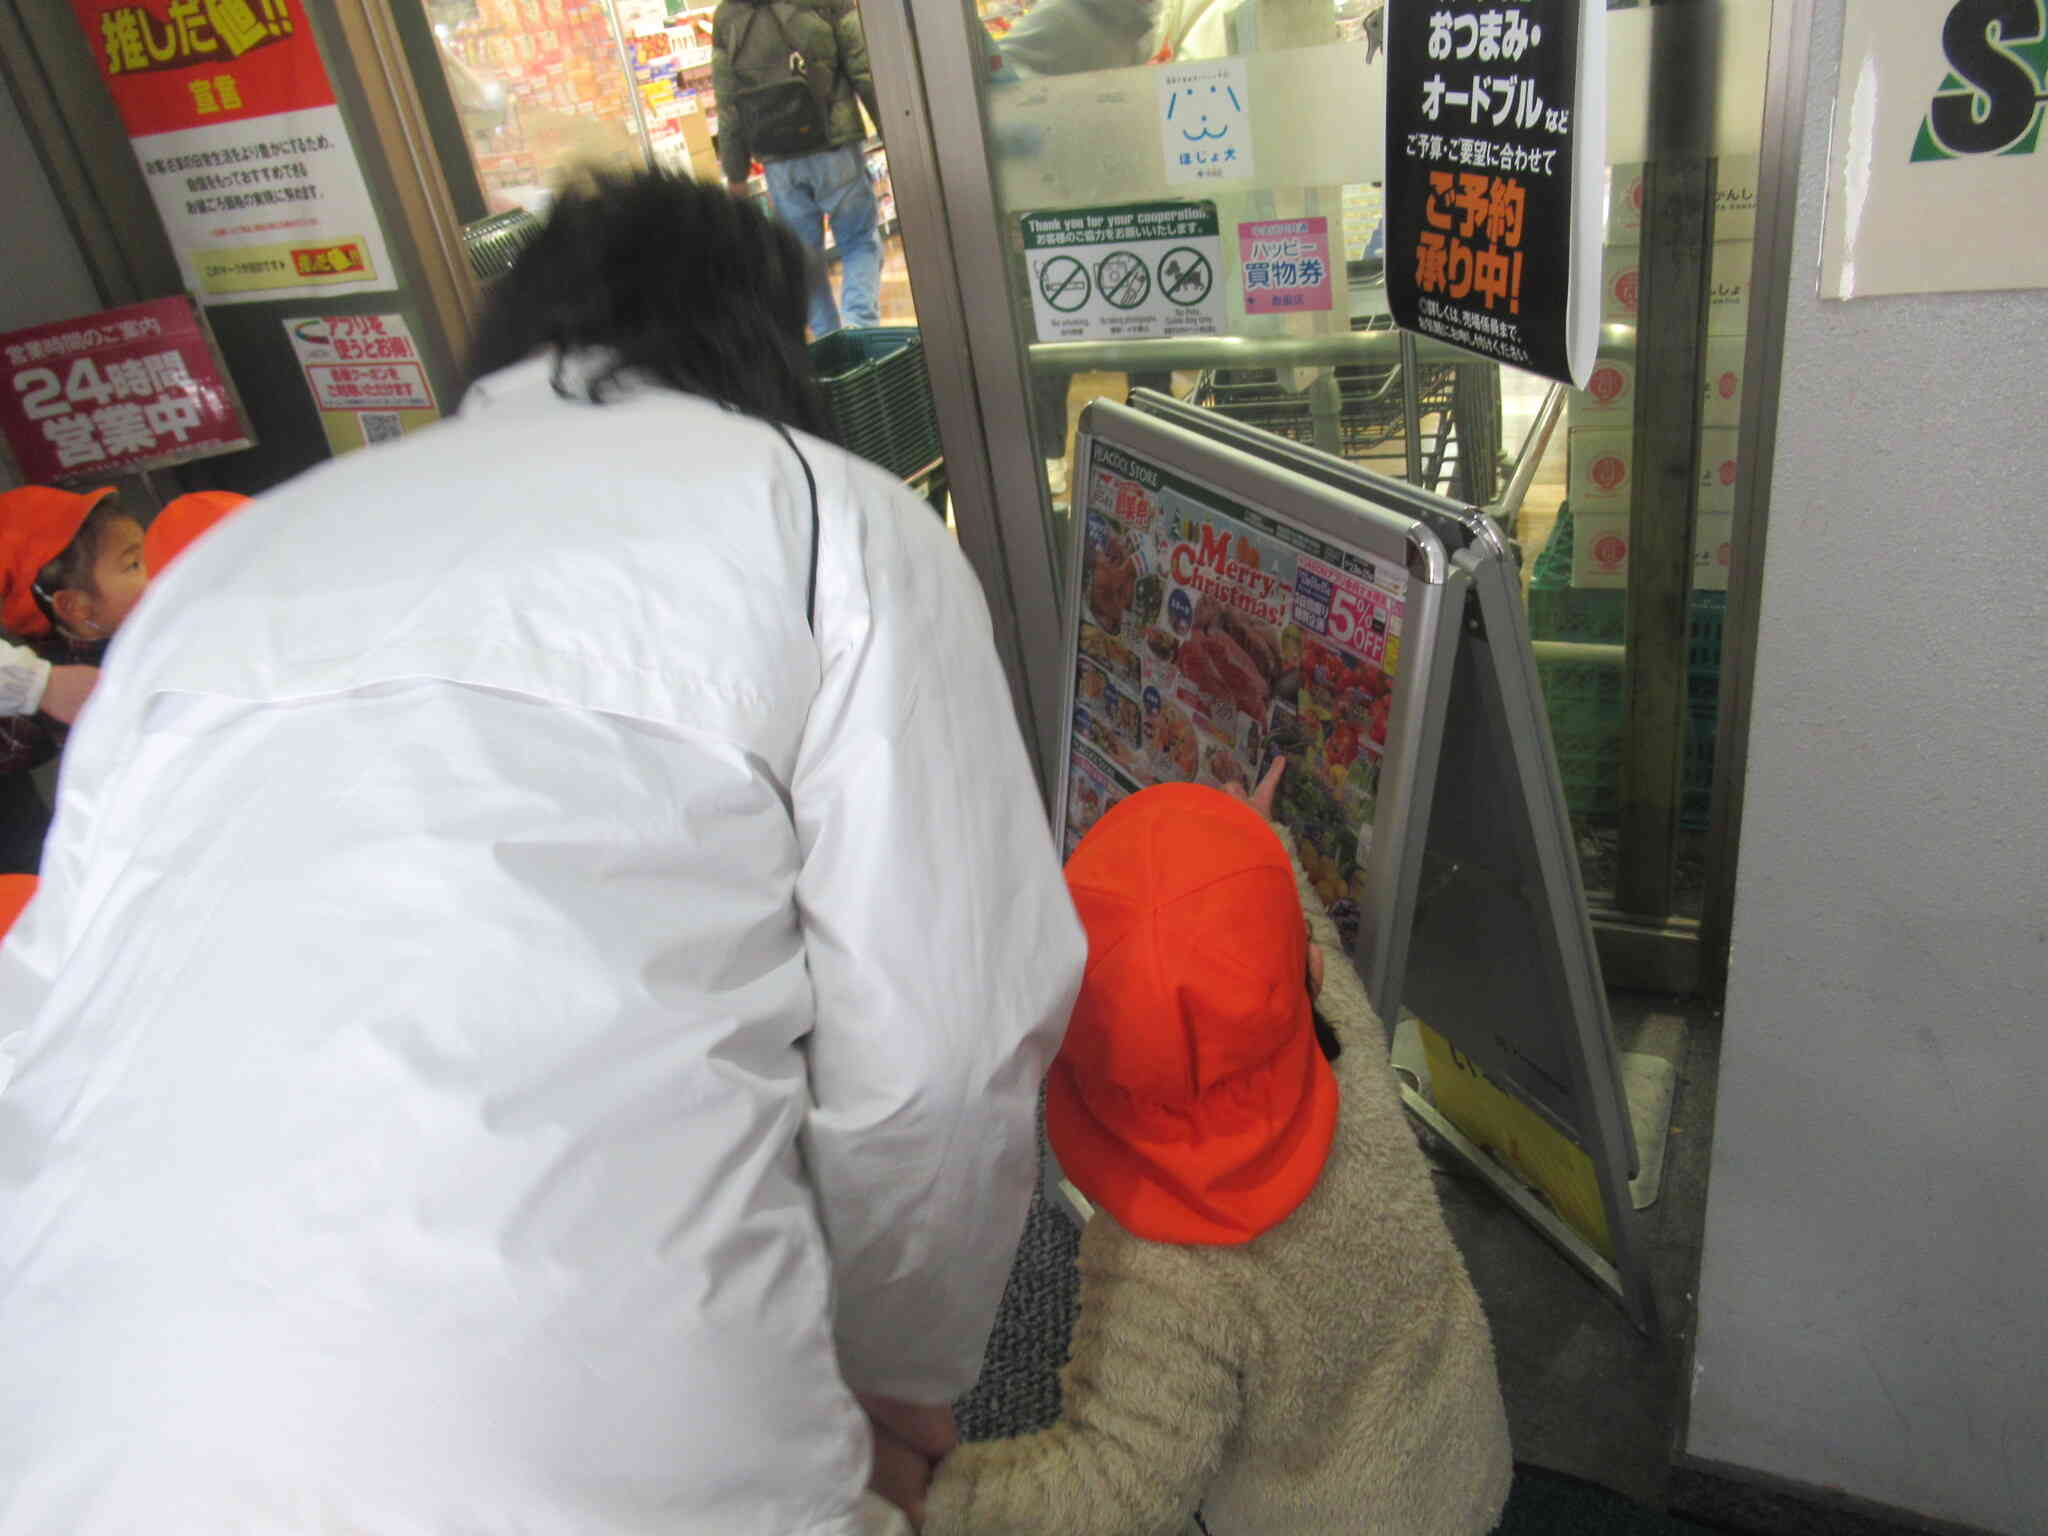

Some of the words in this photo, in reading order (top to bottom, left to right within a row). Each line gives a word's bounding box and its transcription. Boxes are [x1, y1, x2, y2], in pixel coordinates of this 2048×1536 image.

[1406, 133, 1556, 176] ご予算・ご要望に合わせて
[1064, 217, 1084, 231] you
[1426, 171, 1526, 248] ご予約
[1244, 258, 1323, 289] 買物券
[12, 349, 192, 421] 24時間
[42, 393, 202, 468] 営業中
[1197, 523, 1275, 598] Merry
